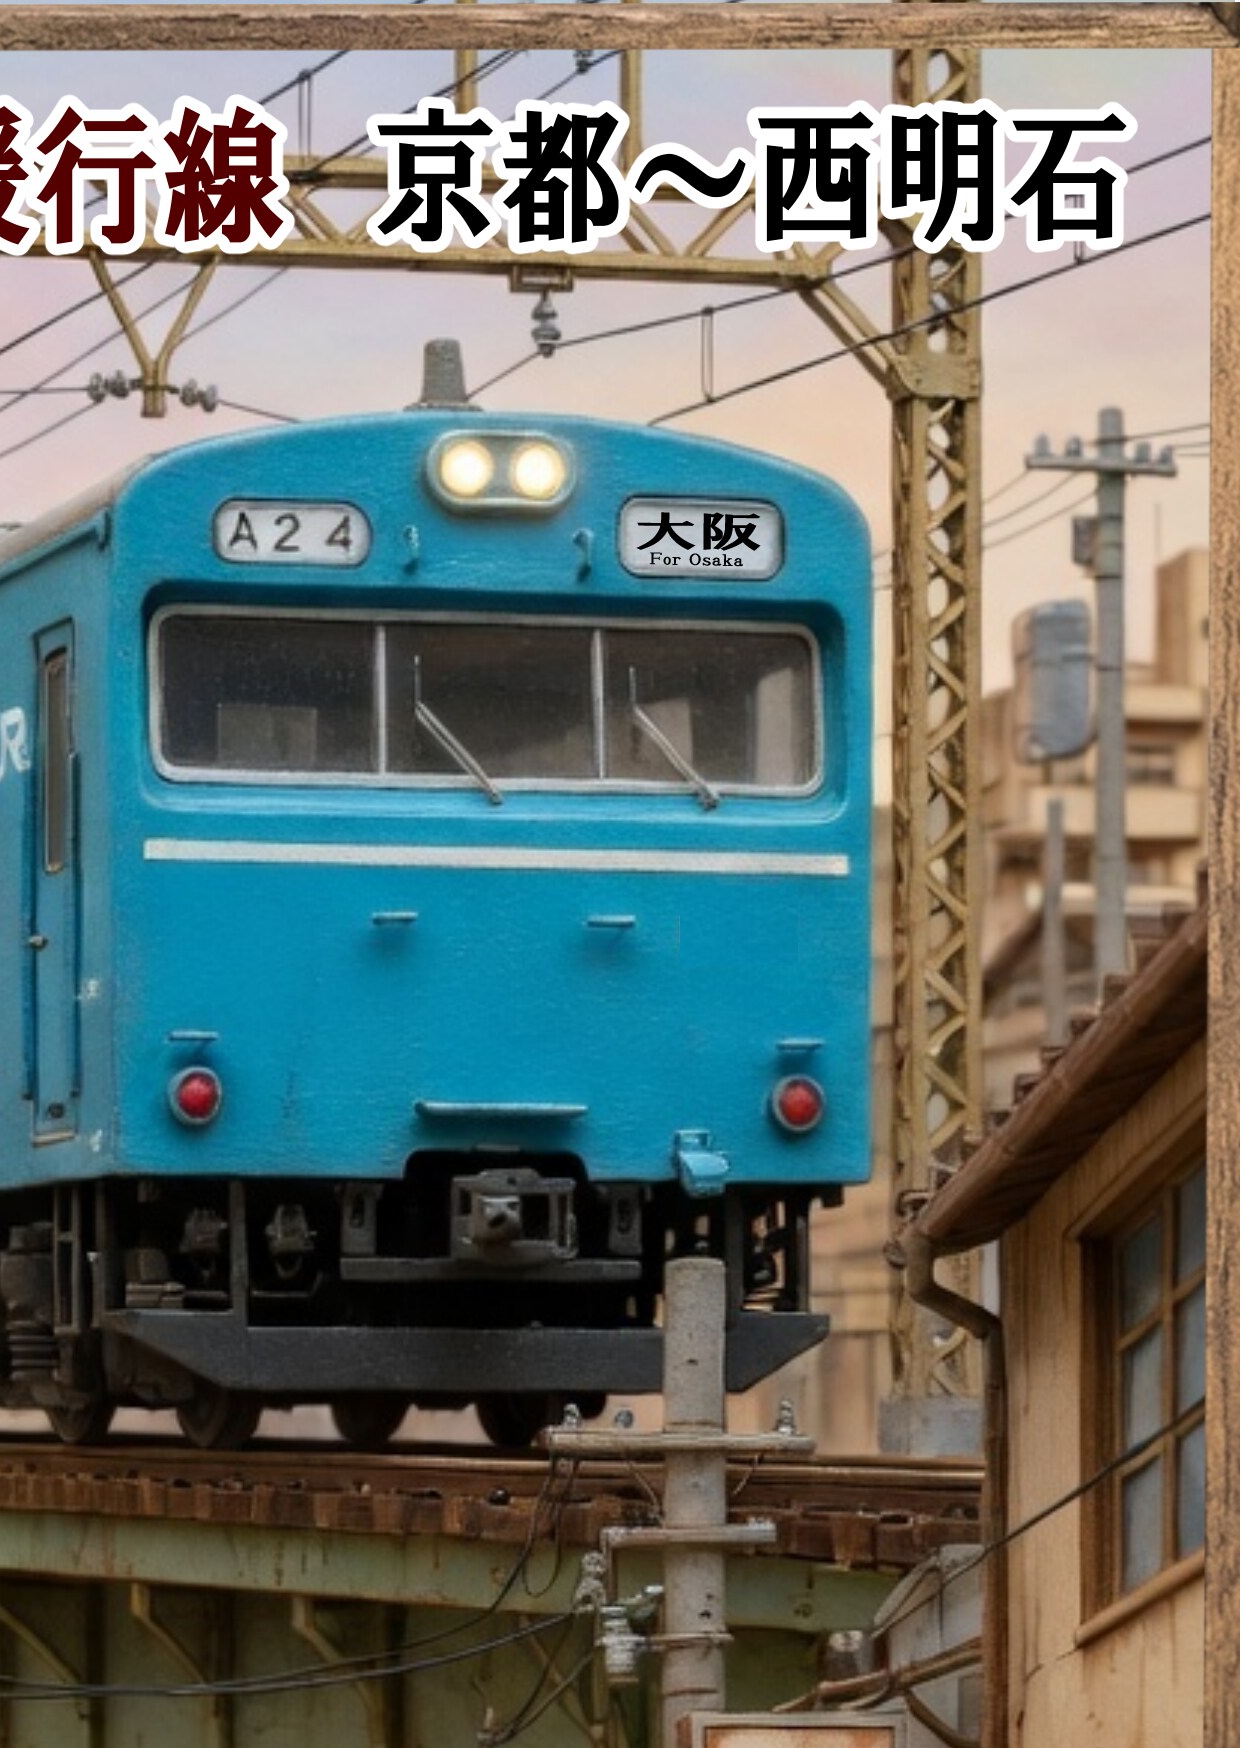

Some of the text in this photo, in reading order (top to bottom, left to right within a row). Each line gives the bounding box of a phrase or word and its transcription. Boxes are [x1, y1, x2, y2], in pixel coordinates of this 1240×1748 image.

[637, 511, 761, 551] 大阪
[649, 551, 744, 567] For Osaka
